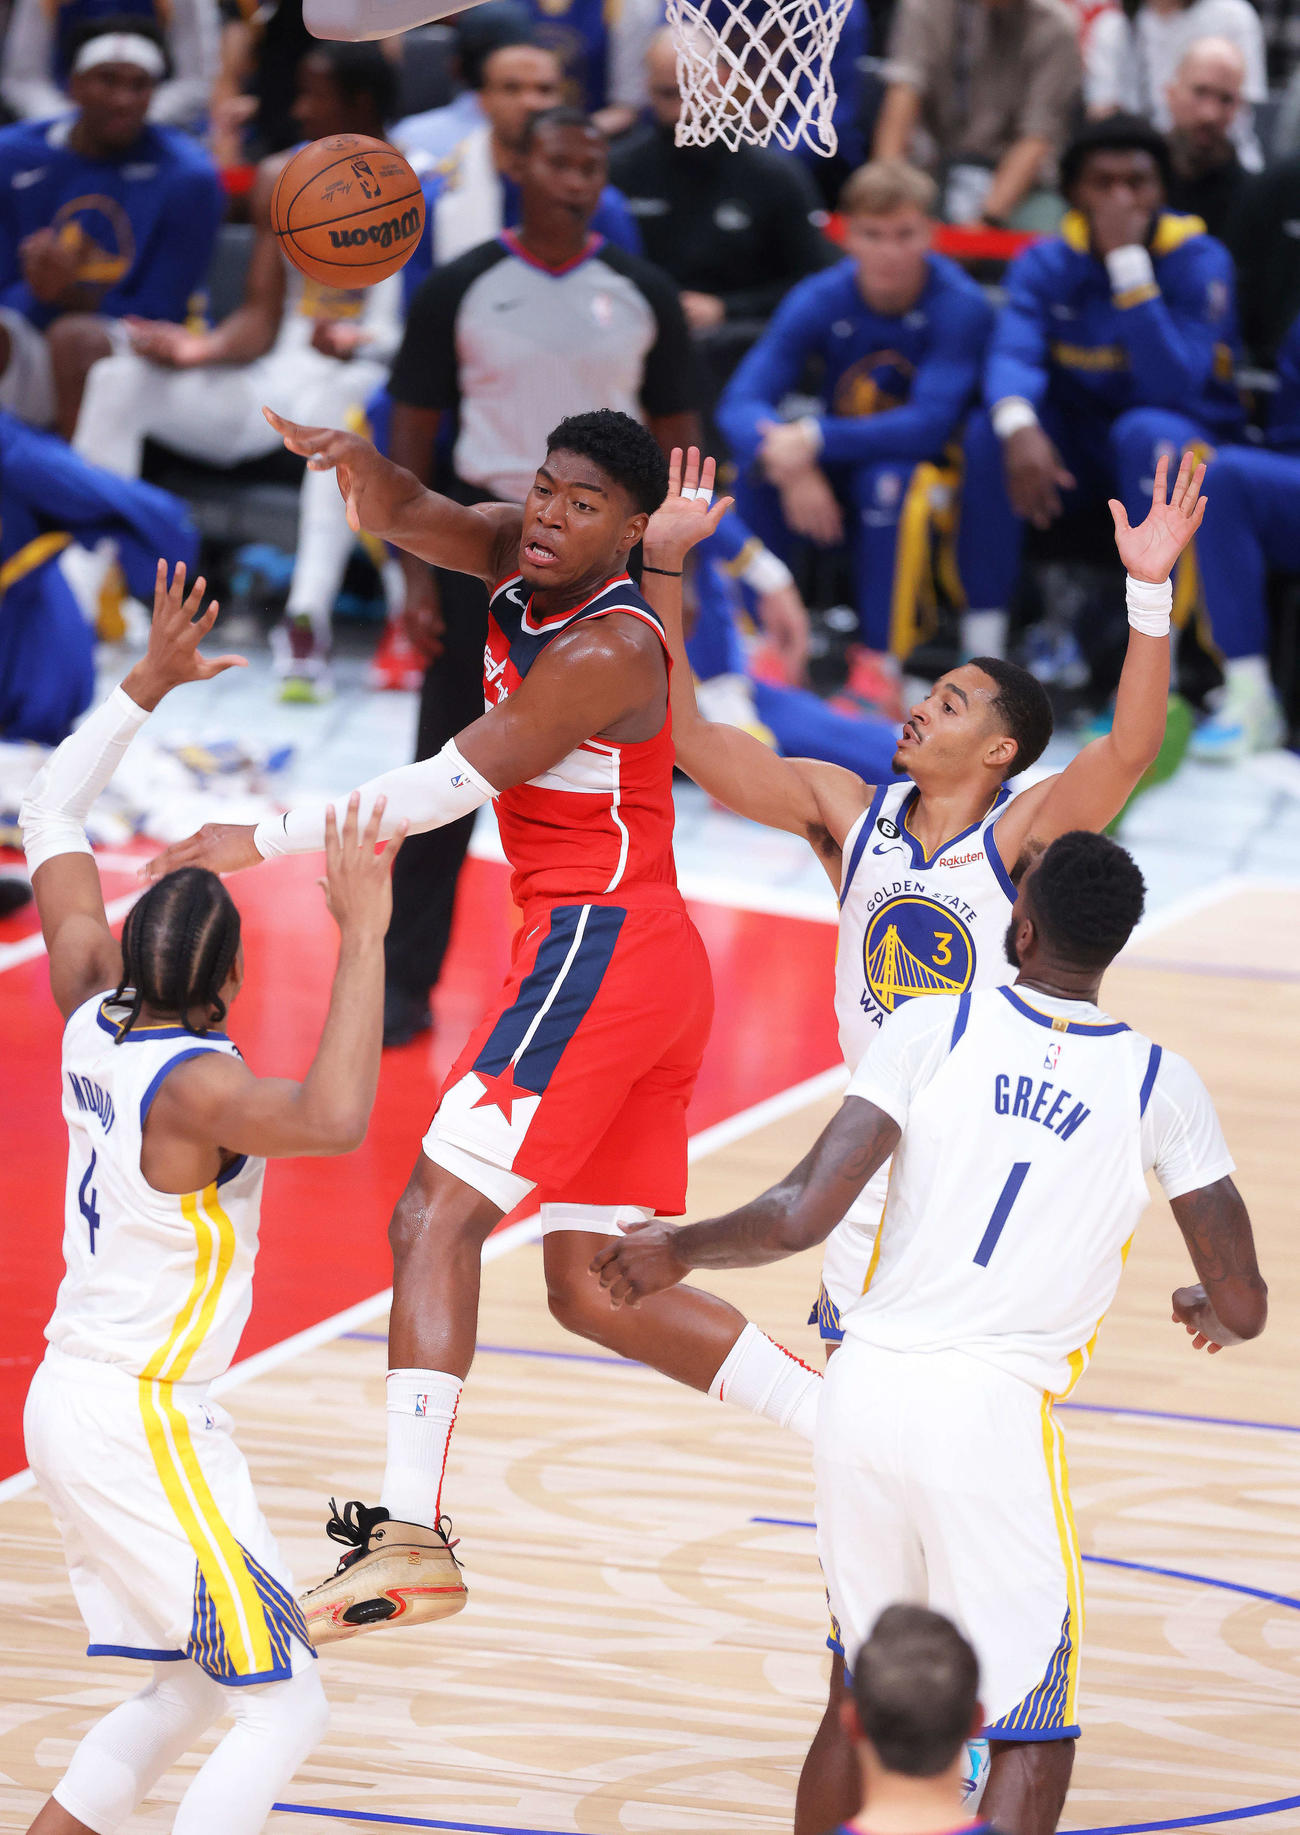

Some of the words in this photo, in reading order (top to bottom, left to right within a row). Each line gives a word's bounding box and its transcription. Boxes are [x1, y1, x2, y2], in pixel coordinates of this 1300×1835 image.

[328, 206, 421, 248] Wilson
[879, 820, 899, 837] 6
[939, 851, 984, 869] Rakuten
[866, 880, 925, 912] GOLDEN
[932, 892, 977, 924] STATE
[931, 931, 953, 966] 3
[994, 1073, 1092, 1142] GREEN
[78, 1147, 100, 1255] 4
[972, 1162, 1032, 1268] 1
